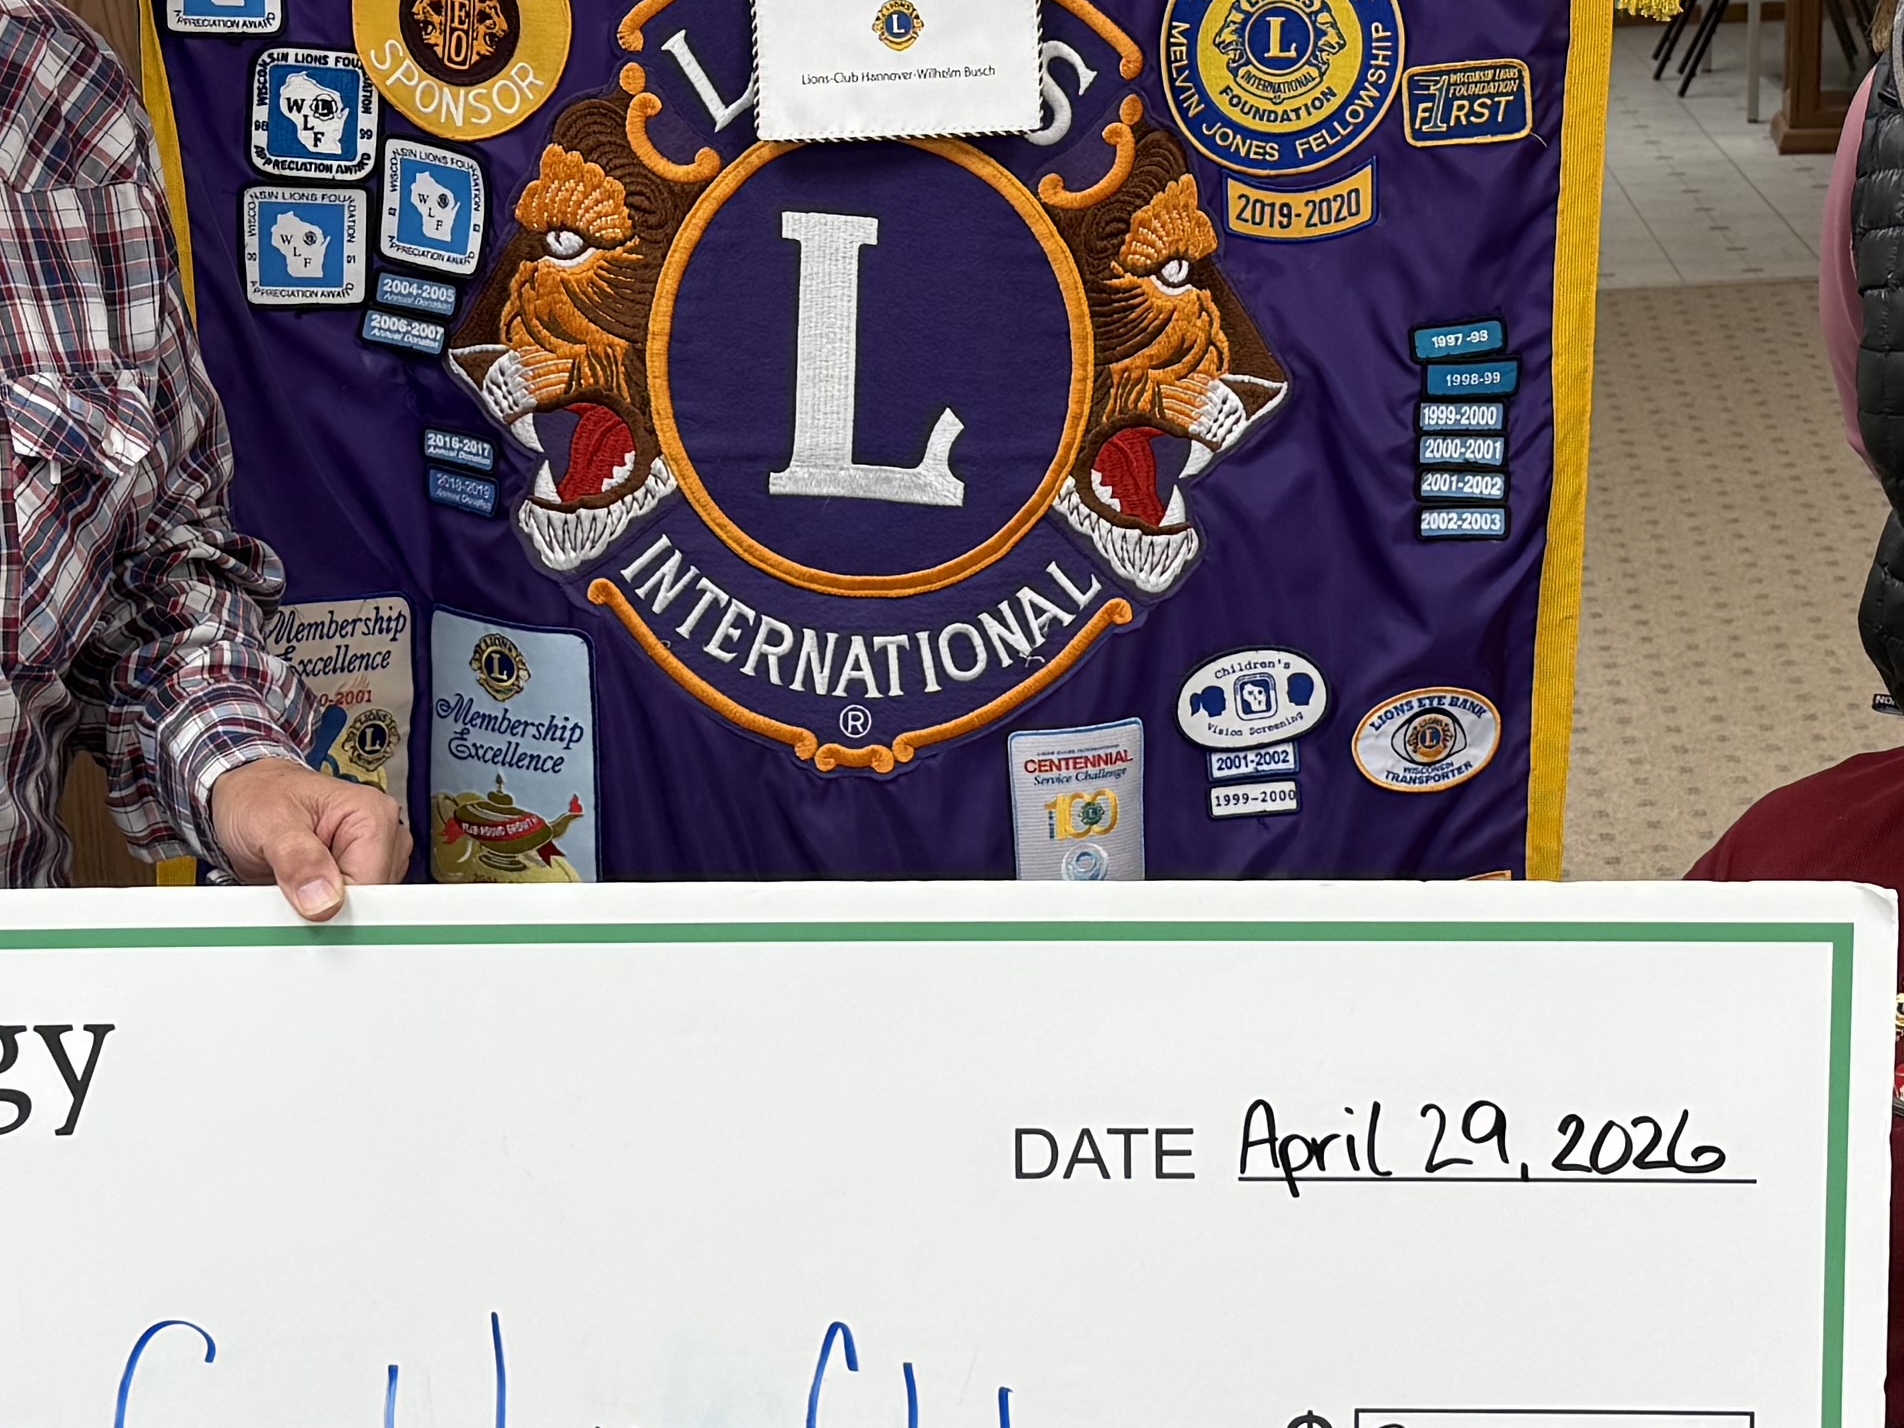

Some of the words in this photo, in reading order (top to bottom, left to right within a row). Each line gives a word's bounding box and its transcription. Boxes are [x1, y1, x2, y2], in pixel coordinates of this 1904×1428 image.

[1264, 16, 1297, 58] L
[370, 38, 545, 127] SPONSOR
[1169, 21, 1205, 119] MELVIN
[1202, 122, 1280, 162] JONES
[1295, 21, 1392, 159] FELLOWSHIP
[1219, 85, 1338, 124] FOUNDATION
[1236, 187, 1361, 230] 2019-2020
[768, 211, 965, 506] L
[1423, 406, 1496, 426] 1999-2000
[1425, 439, 1501, 459] 2000-2001
[1422, 473, 1502, 495] 2001-2002
[1421, 512, 1501, 530] 2002-2003
[263, 606, 407, 646] Membership
[620, 533, 1102, 700] INTERNATIONAL
[1214, 658, 1291, 680] Children's
[436, 692, 585, 750] Membership
[1248, 711, 1304, 736] Screening
[1368, 701, 1415, 733] LIONS
[1417, 695, 1446, 710] EYE
[1447, 696, 1488, 721] BANK
[448, 727, 565, 774] Excellence
[1023, 747, 1133, 775] CENTENNIAL
[1216, 749, 1290, 771] 2001-2002
[1384, 761, 1474, 786] TRANSPORTER
[1214, 788, 1297, 807] 1999-2000
[1012, 1128, 1198, 1182] DATE
[1239, 1099, 1395, 1198] April
[1417, 1101, 1531, 1185] 29,
[1552, 1113, 1726, 1175] 2026
